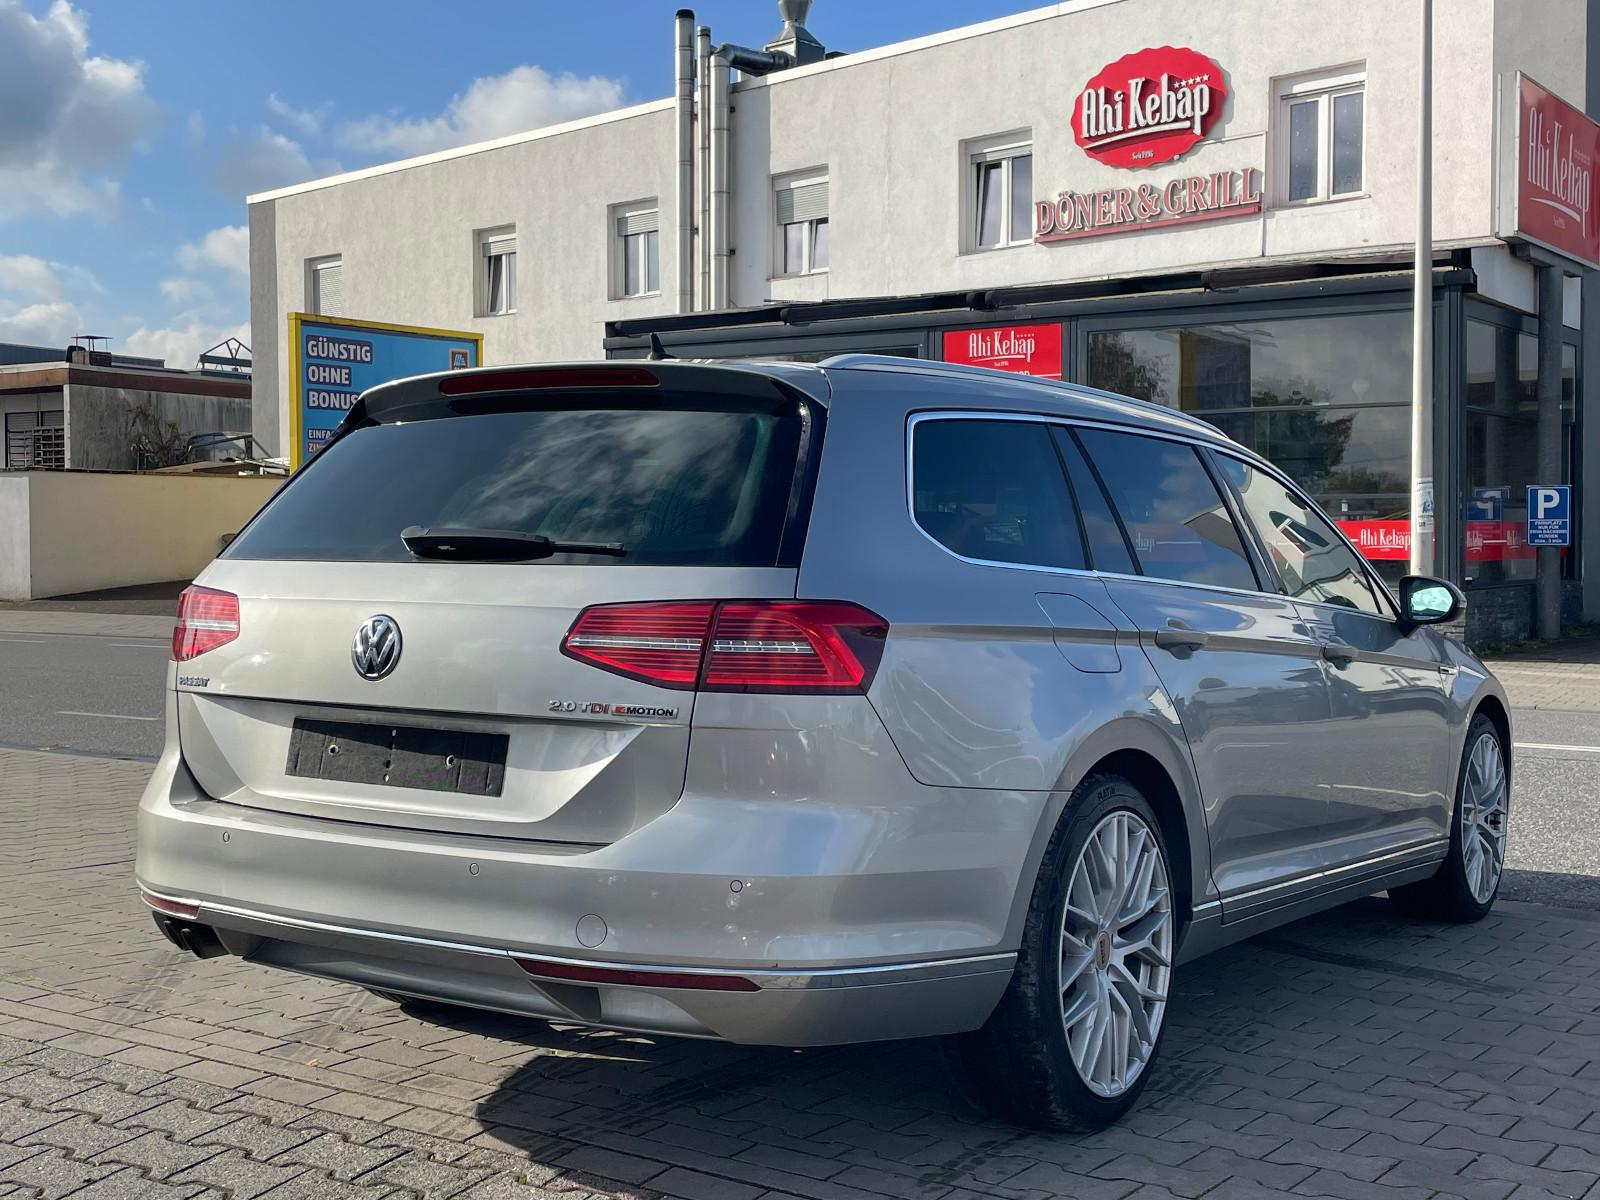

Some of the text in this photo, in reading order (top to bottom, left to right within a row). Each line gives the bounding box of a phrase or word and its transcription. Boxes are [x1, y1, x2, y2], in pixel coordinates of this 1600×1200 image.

[1081, 73, 1210, 138] Ahi Kebap
[1528, 107, 1590, 239] Ahi Kebap
[307, 337, 371, 362] GÜNSTIG
[968, 330, 1035, 363] Ahi Kebap
[308, 366, 350, 385] OHNE
[1537, 490, 1560, 519] P
[1360, 528, 1411, 552] Ahi Kebap
[549, 700, 577, 713] 2.0
[580, 702, 611, 715] TDI
